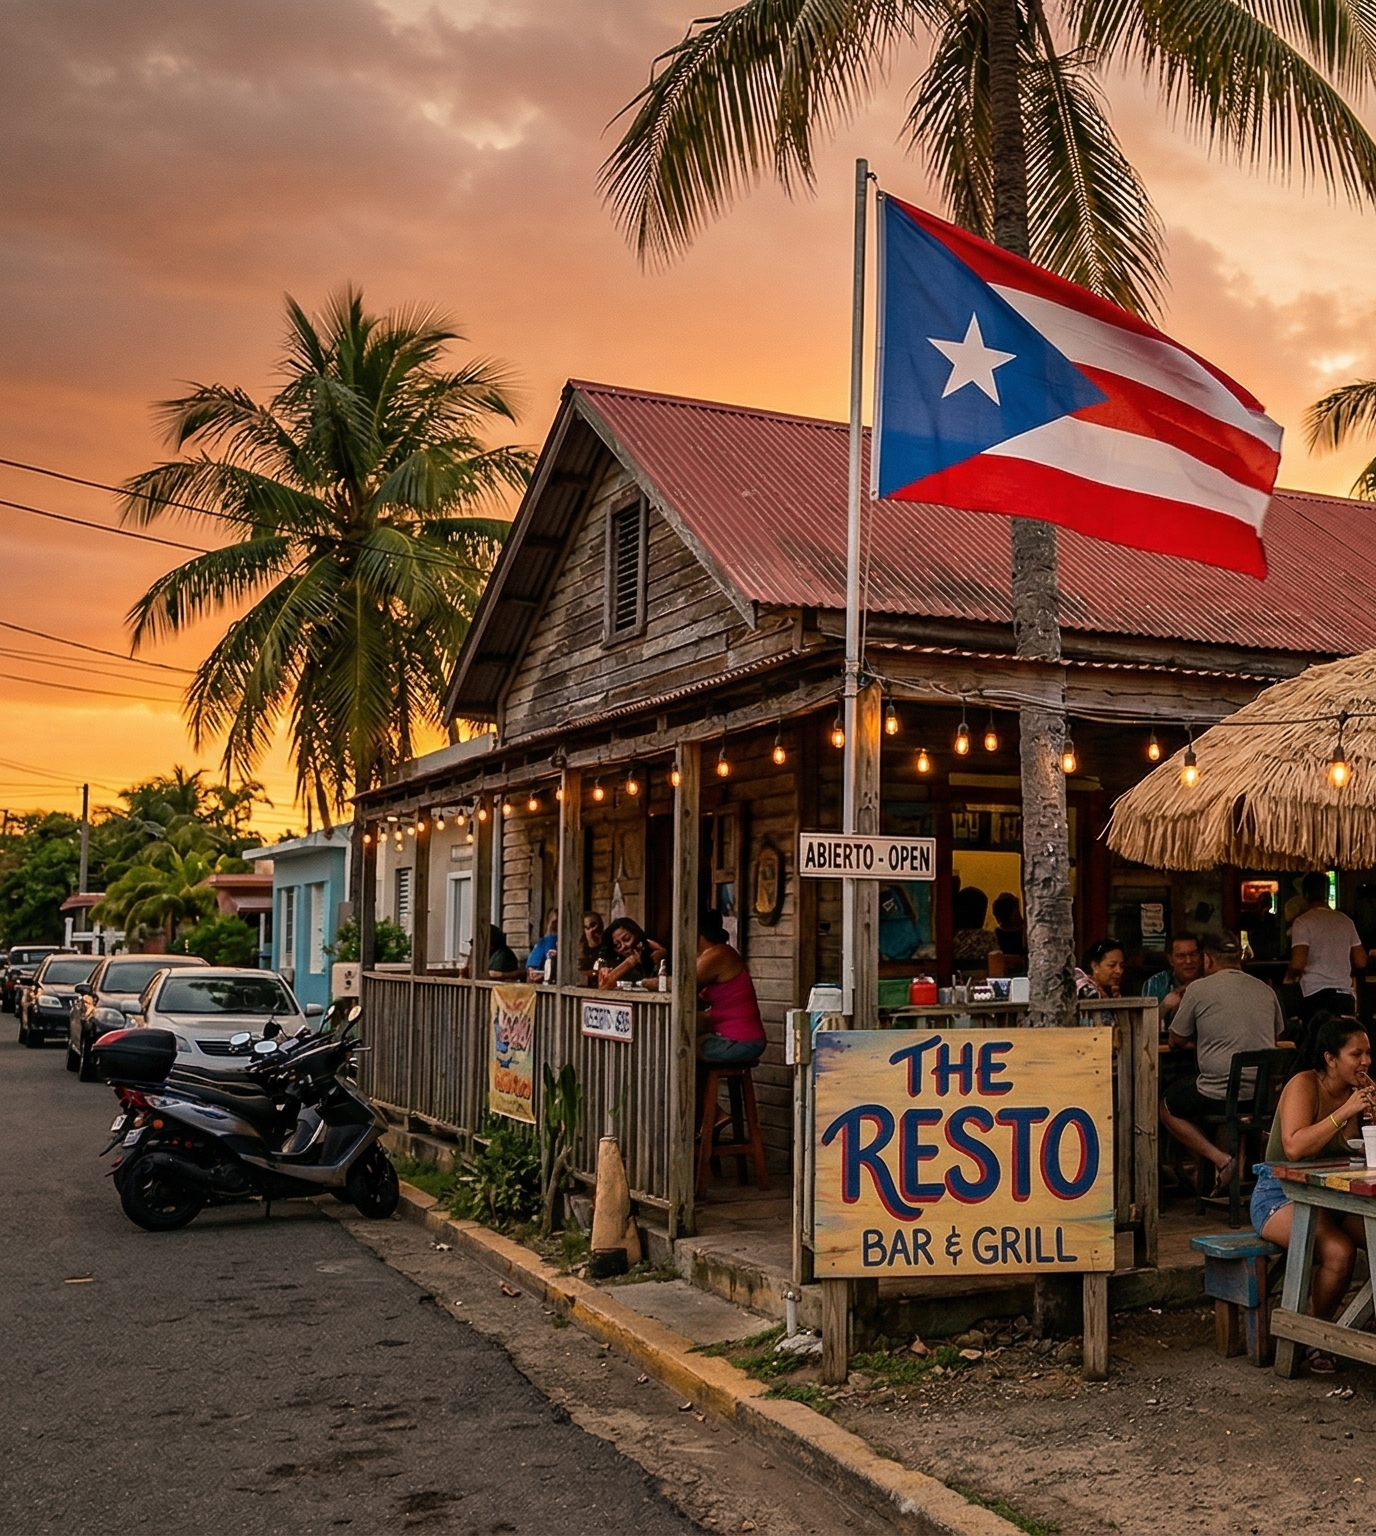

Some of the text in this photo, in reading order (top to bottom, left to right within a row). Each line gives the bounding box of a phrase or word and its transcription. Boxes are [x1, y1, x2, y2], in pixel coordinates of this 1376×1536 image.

[805, 842, 874, 870] ABIERTO
[889, 845, 930, 871] OPEN
[889, 1035, 1014, 1097] THE
[821, 1105, 1099, 1222] RESTO
[863, 1226, 1078, 1266] BAR & GRILL
